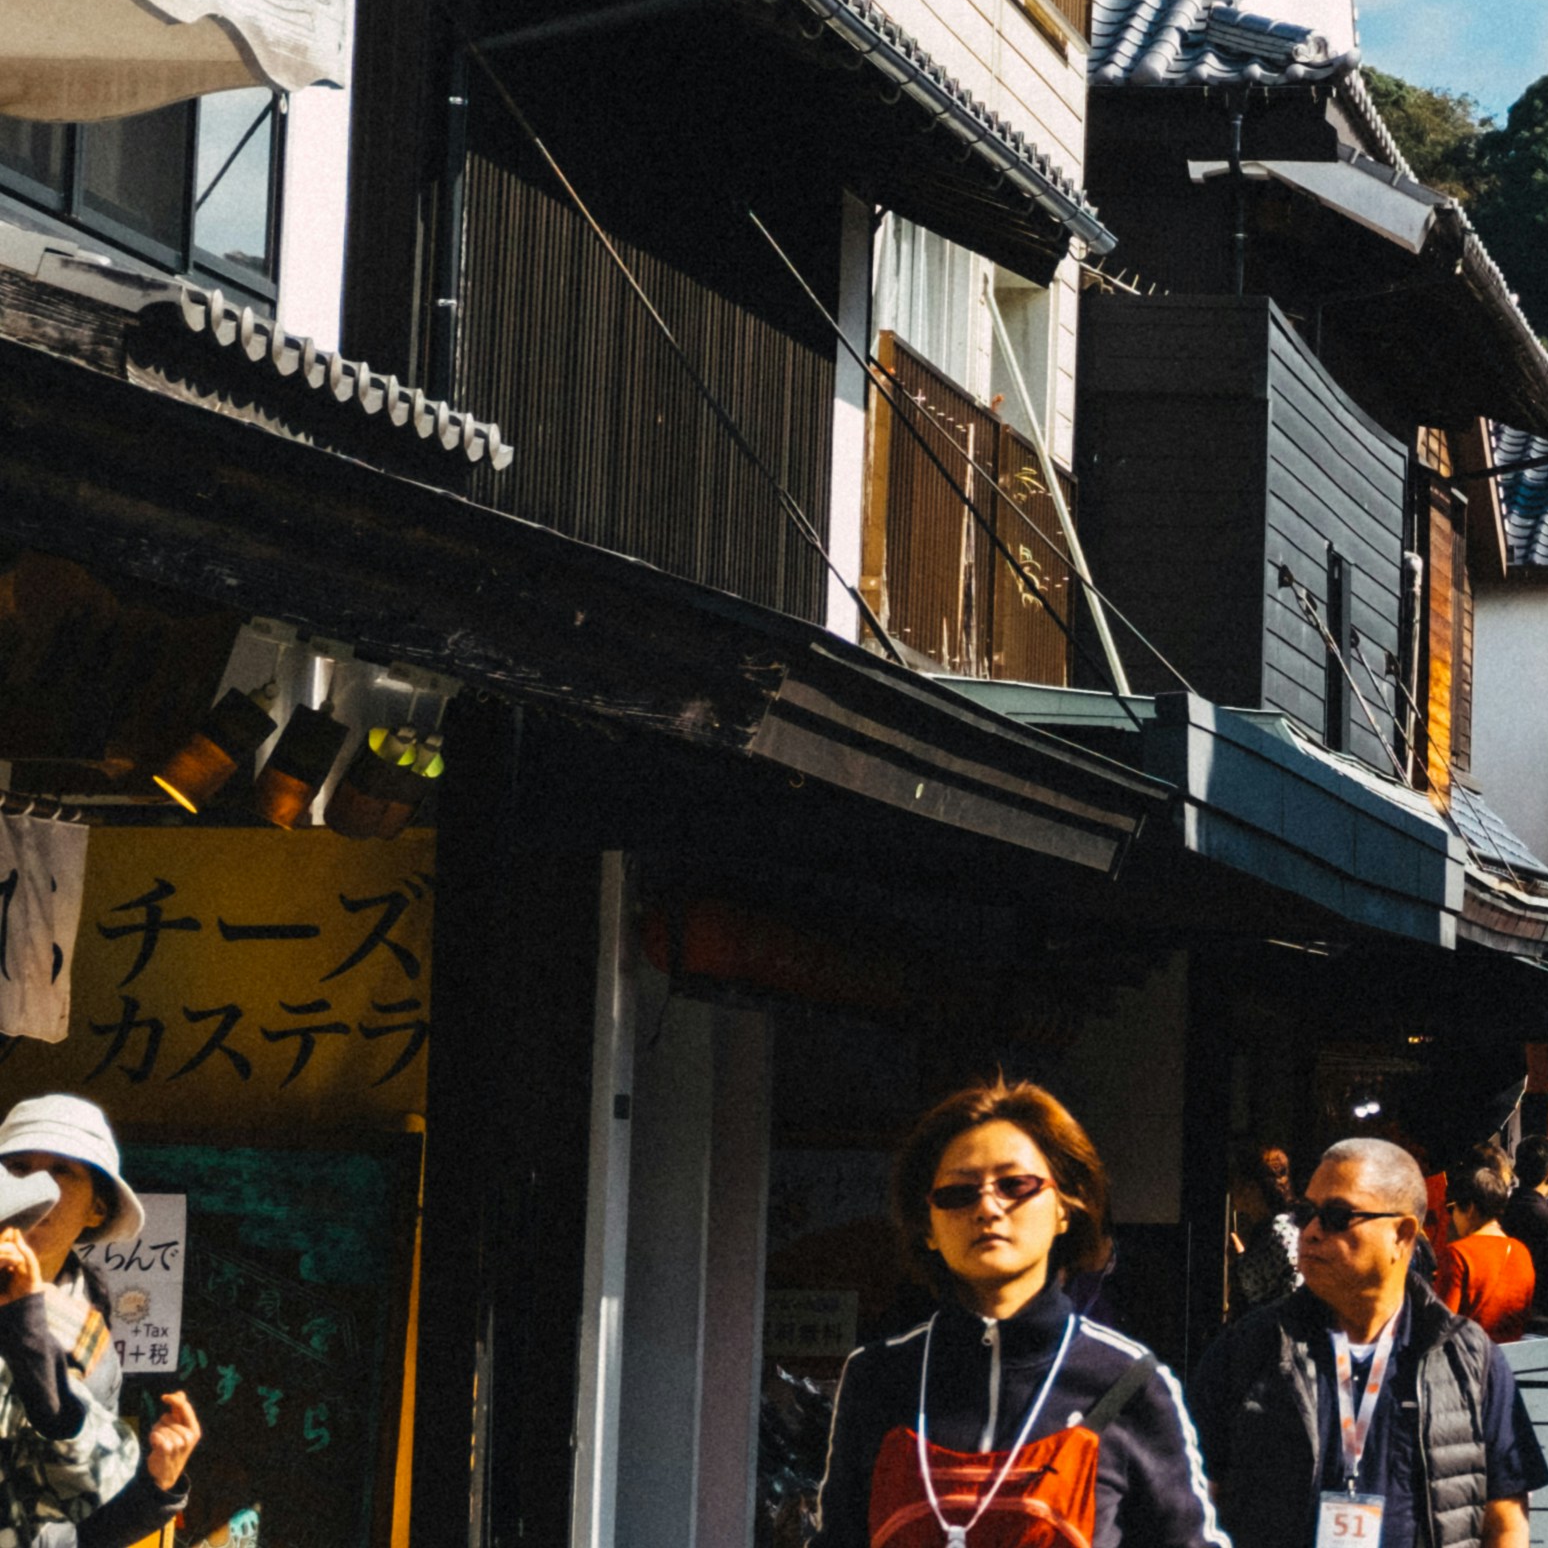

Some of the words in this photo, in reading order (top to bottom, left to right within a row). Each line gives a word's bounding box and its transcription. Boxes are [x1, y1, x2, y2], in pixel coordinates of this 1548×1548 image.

[96, 873, 435, 989] チーズ
[83, 995, 431, 1089] カステラ
[1333, 1512, 1367, 1538] 51
